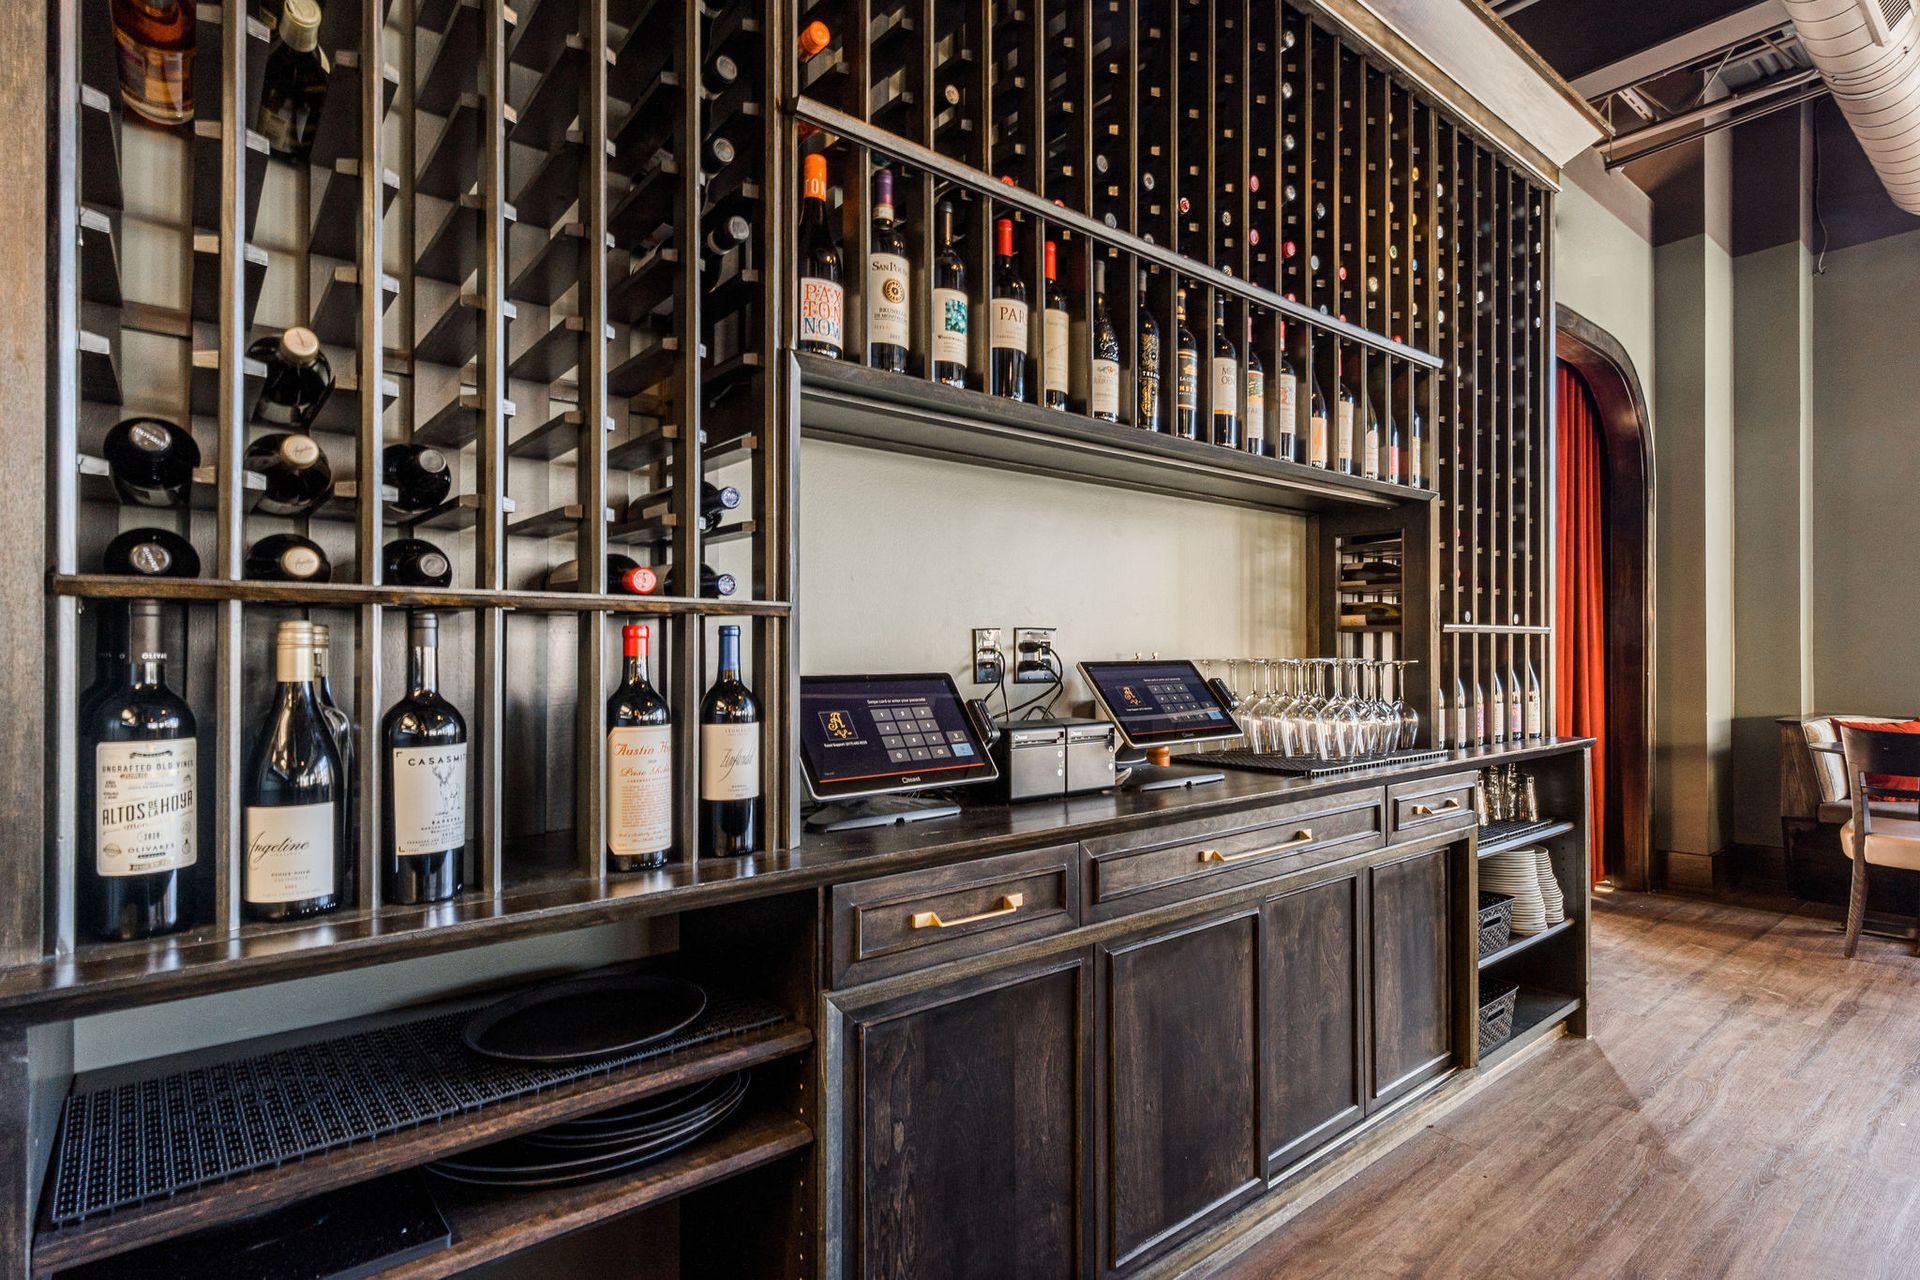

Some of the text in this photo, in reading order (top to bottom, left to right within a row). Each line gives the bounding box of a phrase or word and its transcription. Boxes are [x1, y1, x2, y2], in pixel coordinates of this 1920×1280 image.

[805, 283, 842, 305] PAX
[804, 300, 842, 325] TON
[804, 317, 841, 342] NOW
[613, 743, 655, 755] Austin
[156, 762, 173, 770] OLD
[161, 791, 193, 814] HOYA
[102, 803, 145, 826] ALTOS
